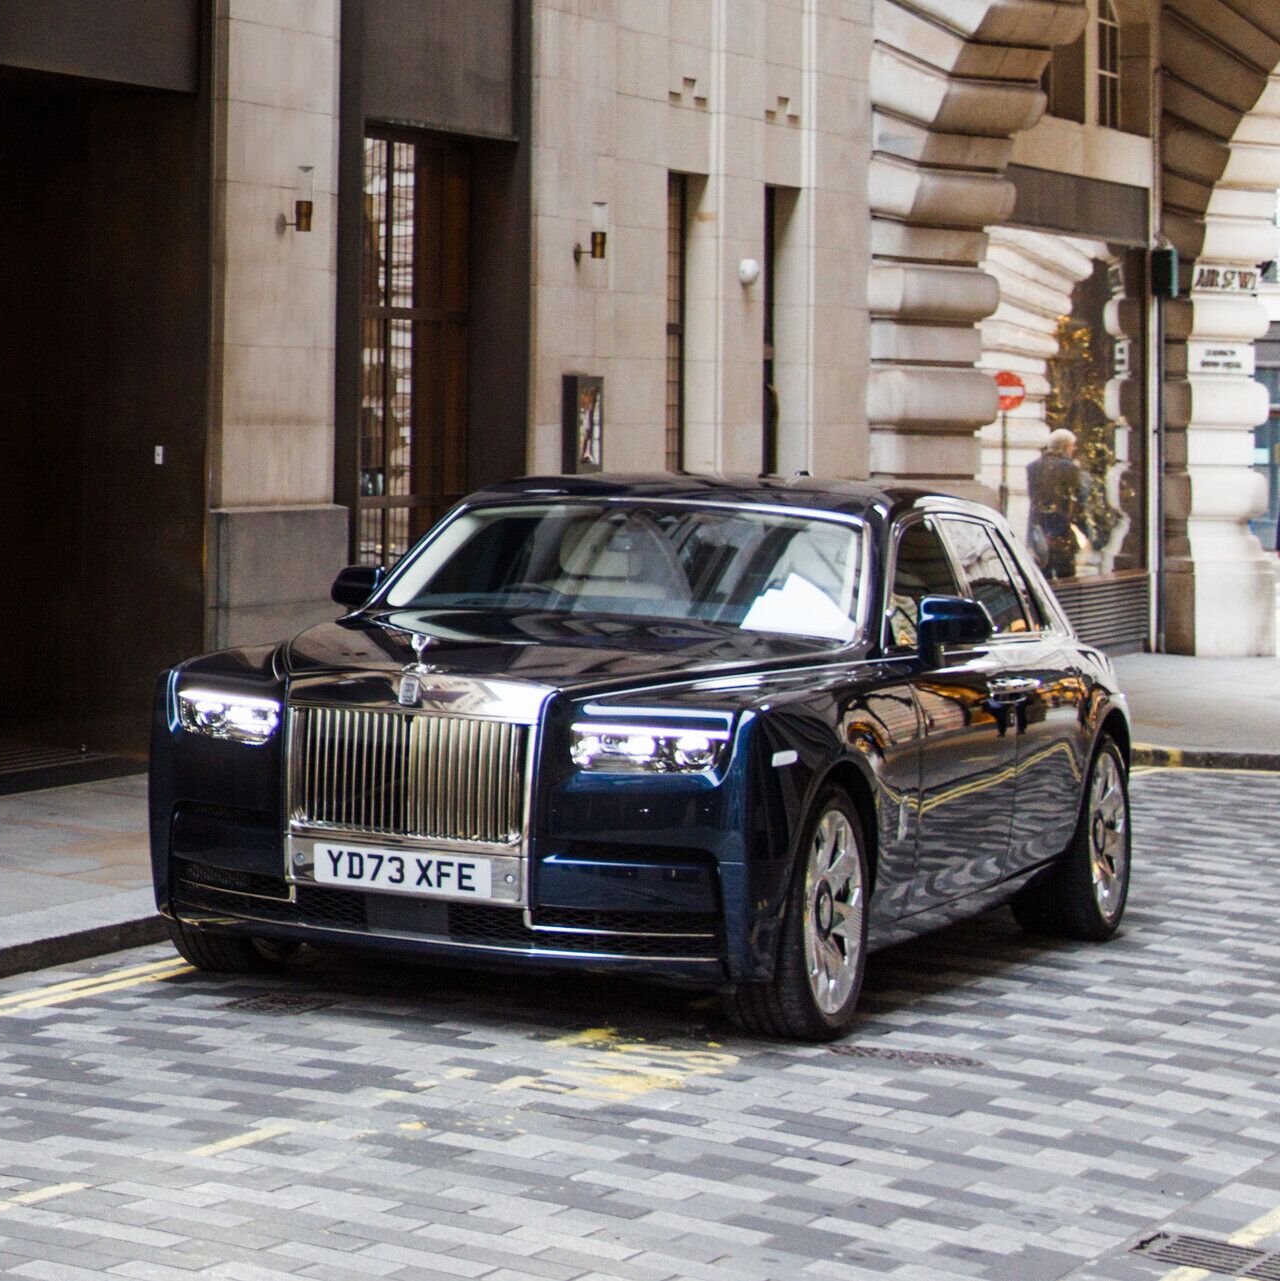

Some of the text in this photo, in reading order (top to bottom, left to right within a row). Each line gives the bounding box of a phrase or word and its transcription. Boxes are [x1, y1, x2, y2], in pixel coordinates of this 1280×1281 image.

[1195, 268, 1220, 288] AIR
[327, 849, 476, 892] YD73 XFE
